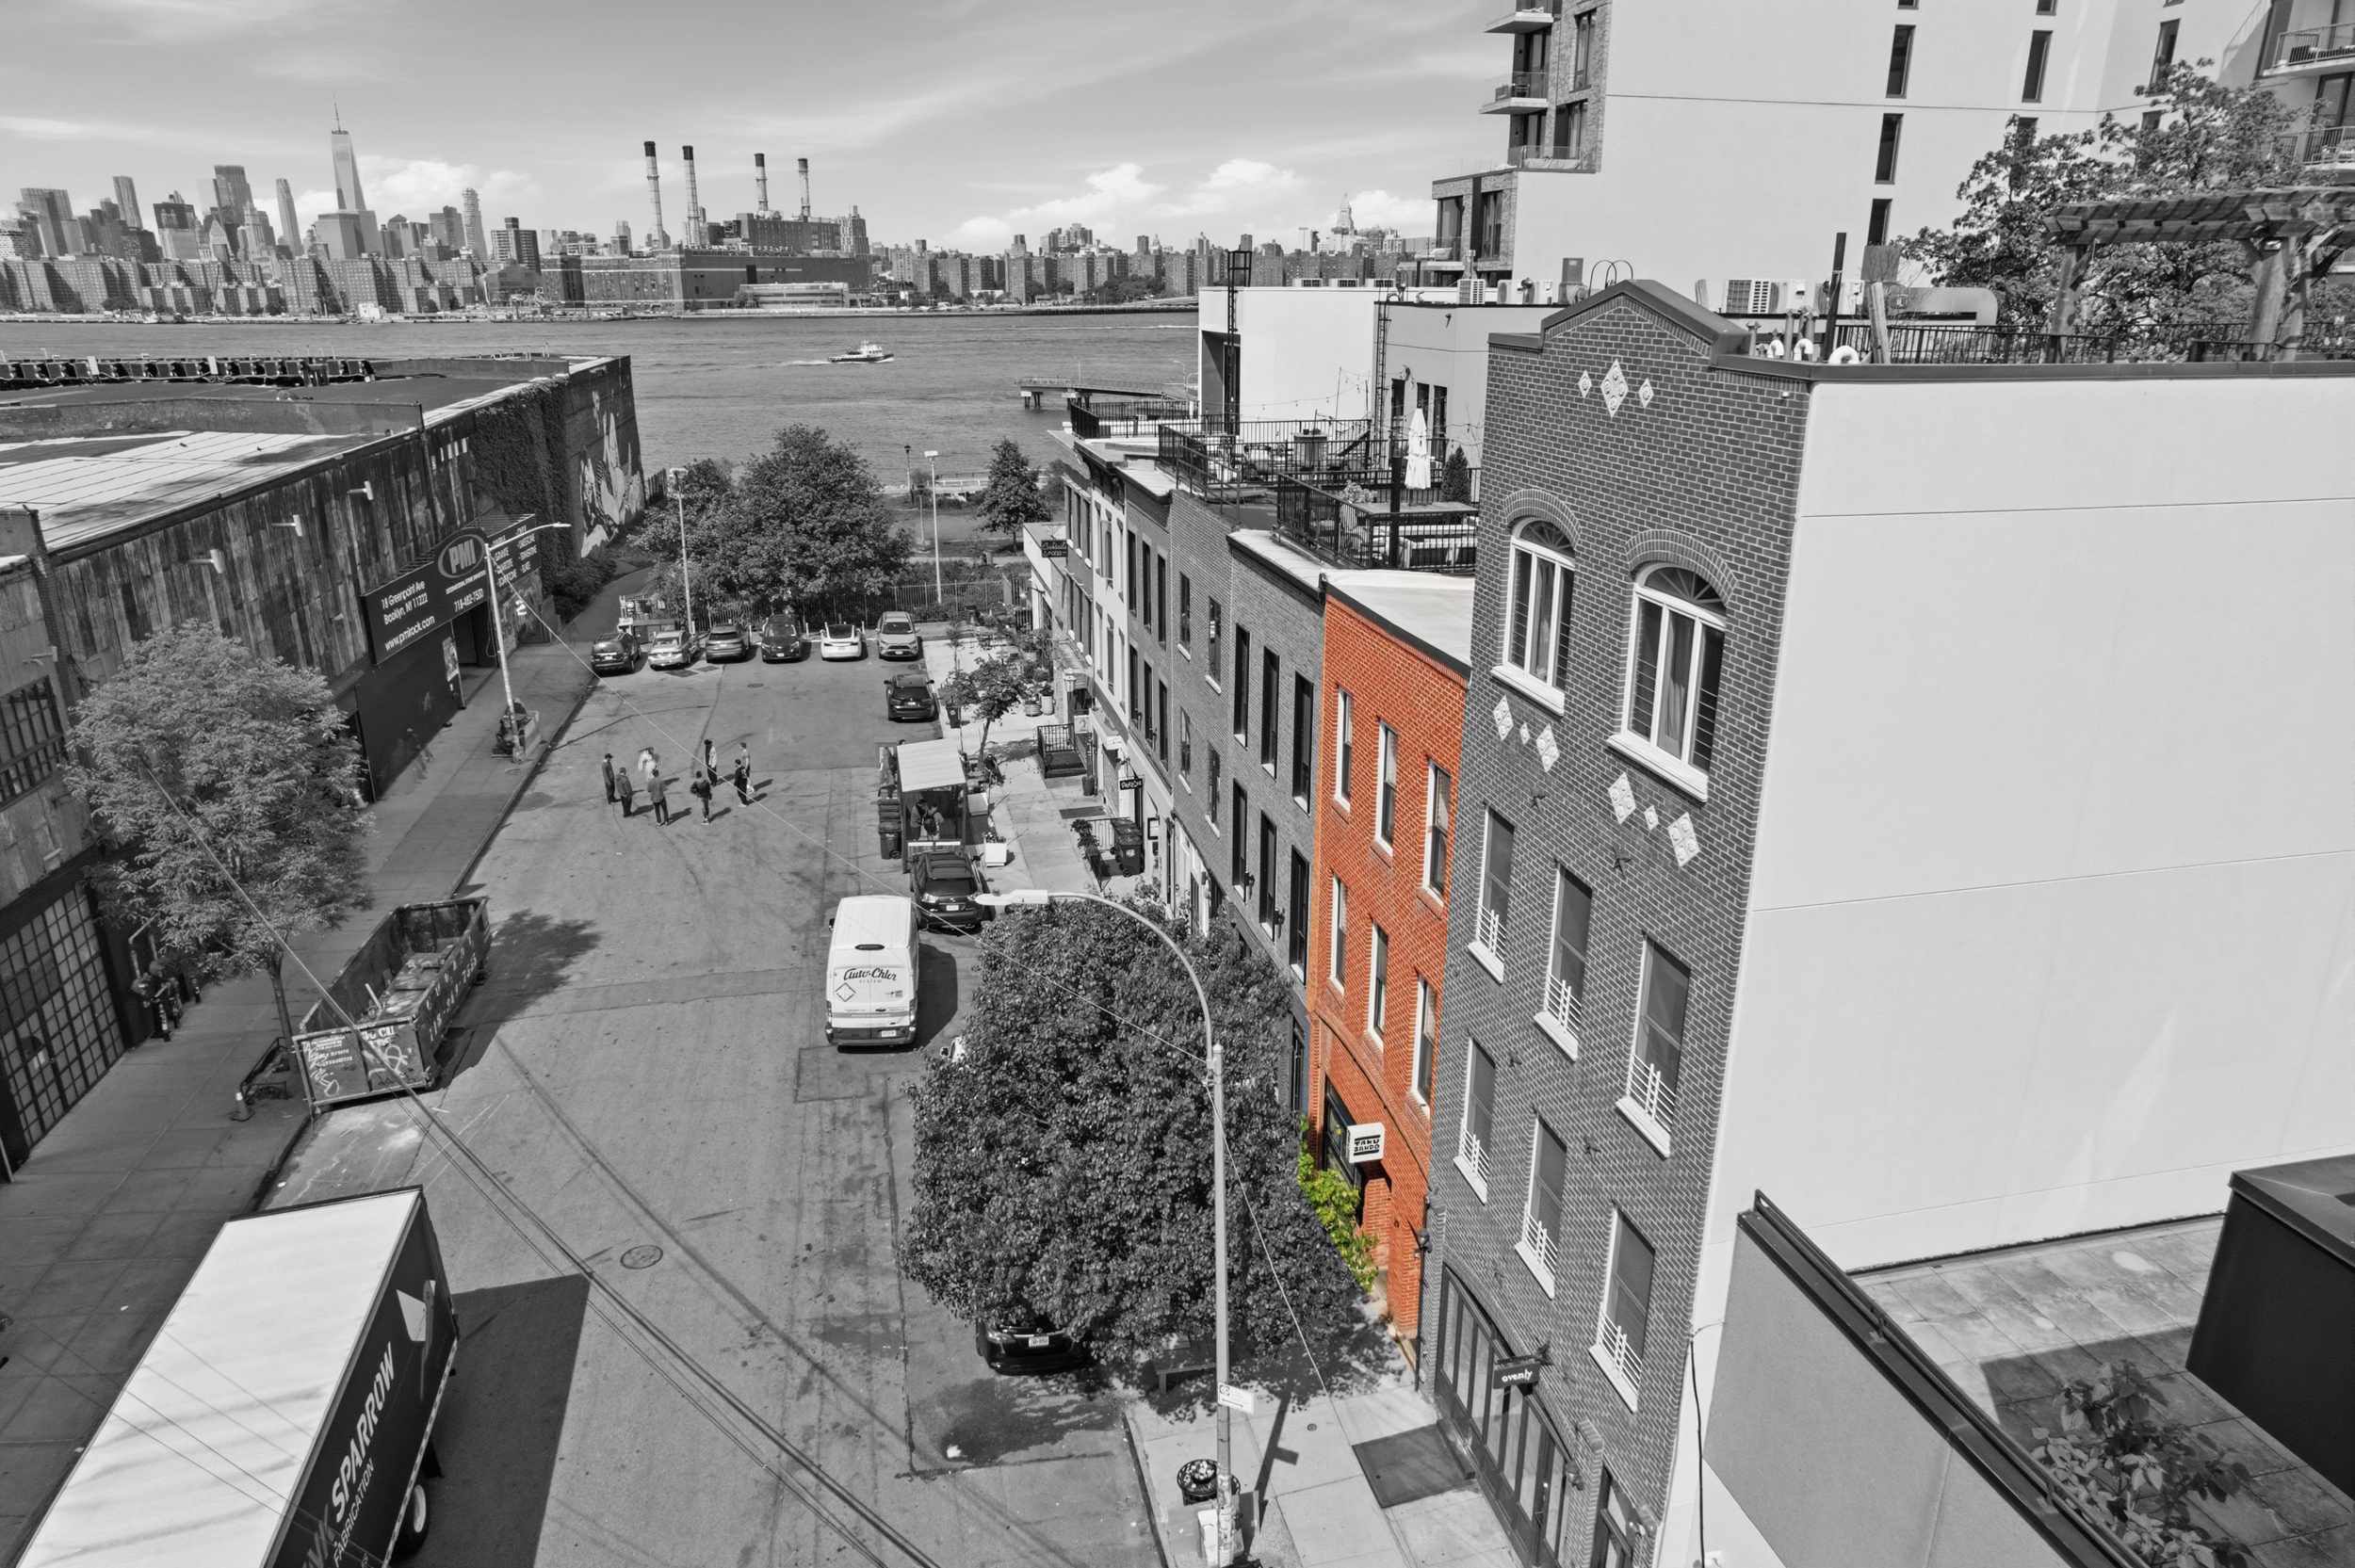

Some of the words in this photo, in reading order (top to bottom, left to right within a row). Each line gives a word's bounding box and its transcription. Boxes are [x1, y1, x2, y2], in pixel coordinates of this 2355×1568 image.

[448, 539, 477, 574] PMI
[388, 583, 415, 606] Greenpoint
[415, 580, 426, 591] Ave
[405, 600, 414, 613] NY
[843, 967, 897, 981] Auto-Chlor
[1502, 1368, 1533, 1382] ovenly
[332, 1341, 394, 1523] SPARROW
[333, 1458, 374, 1568] FABRICATION
